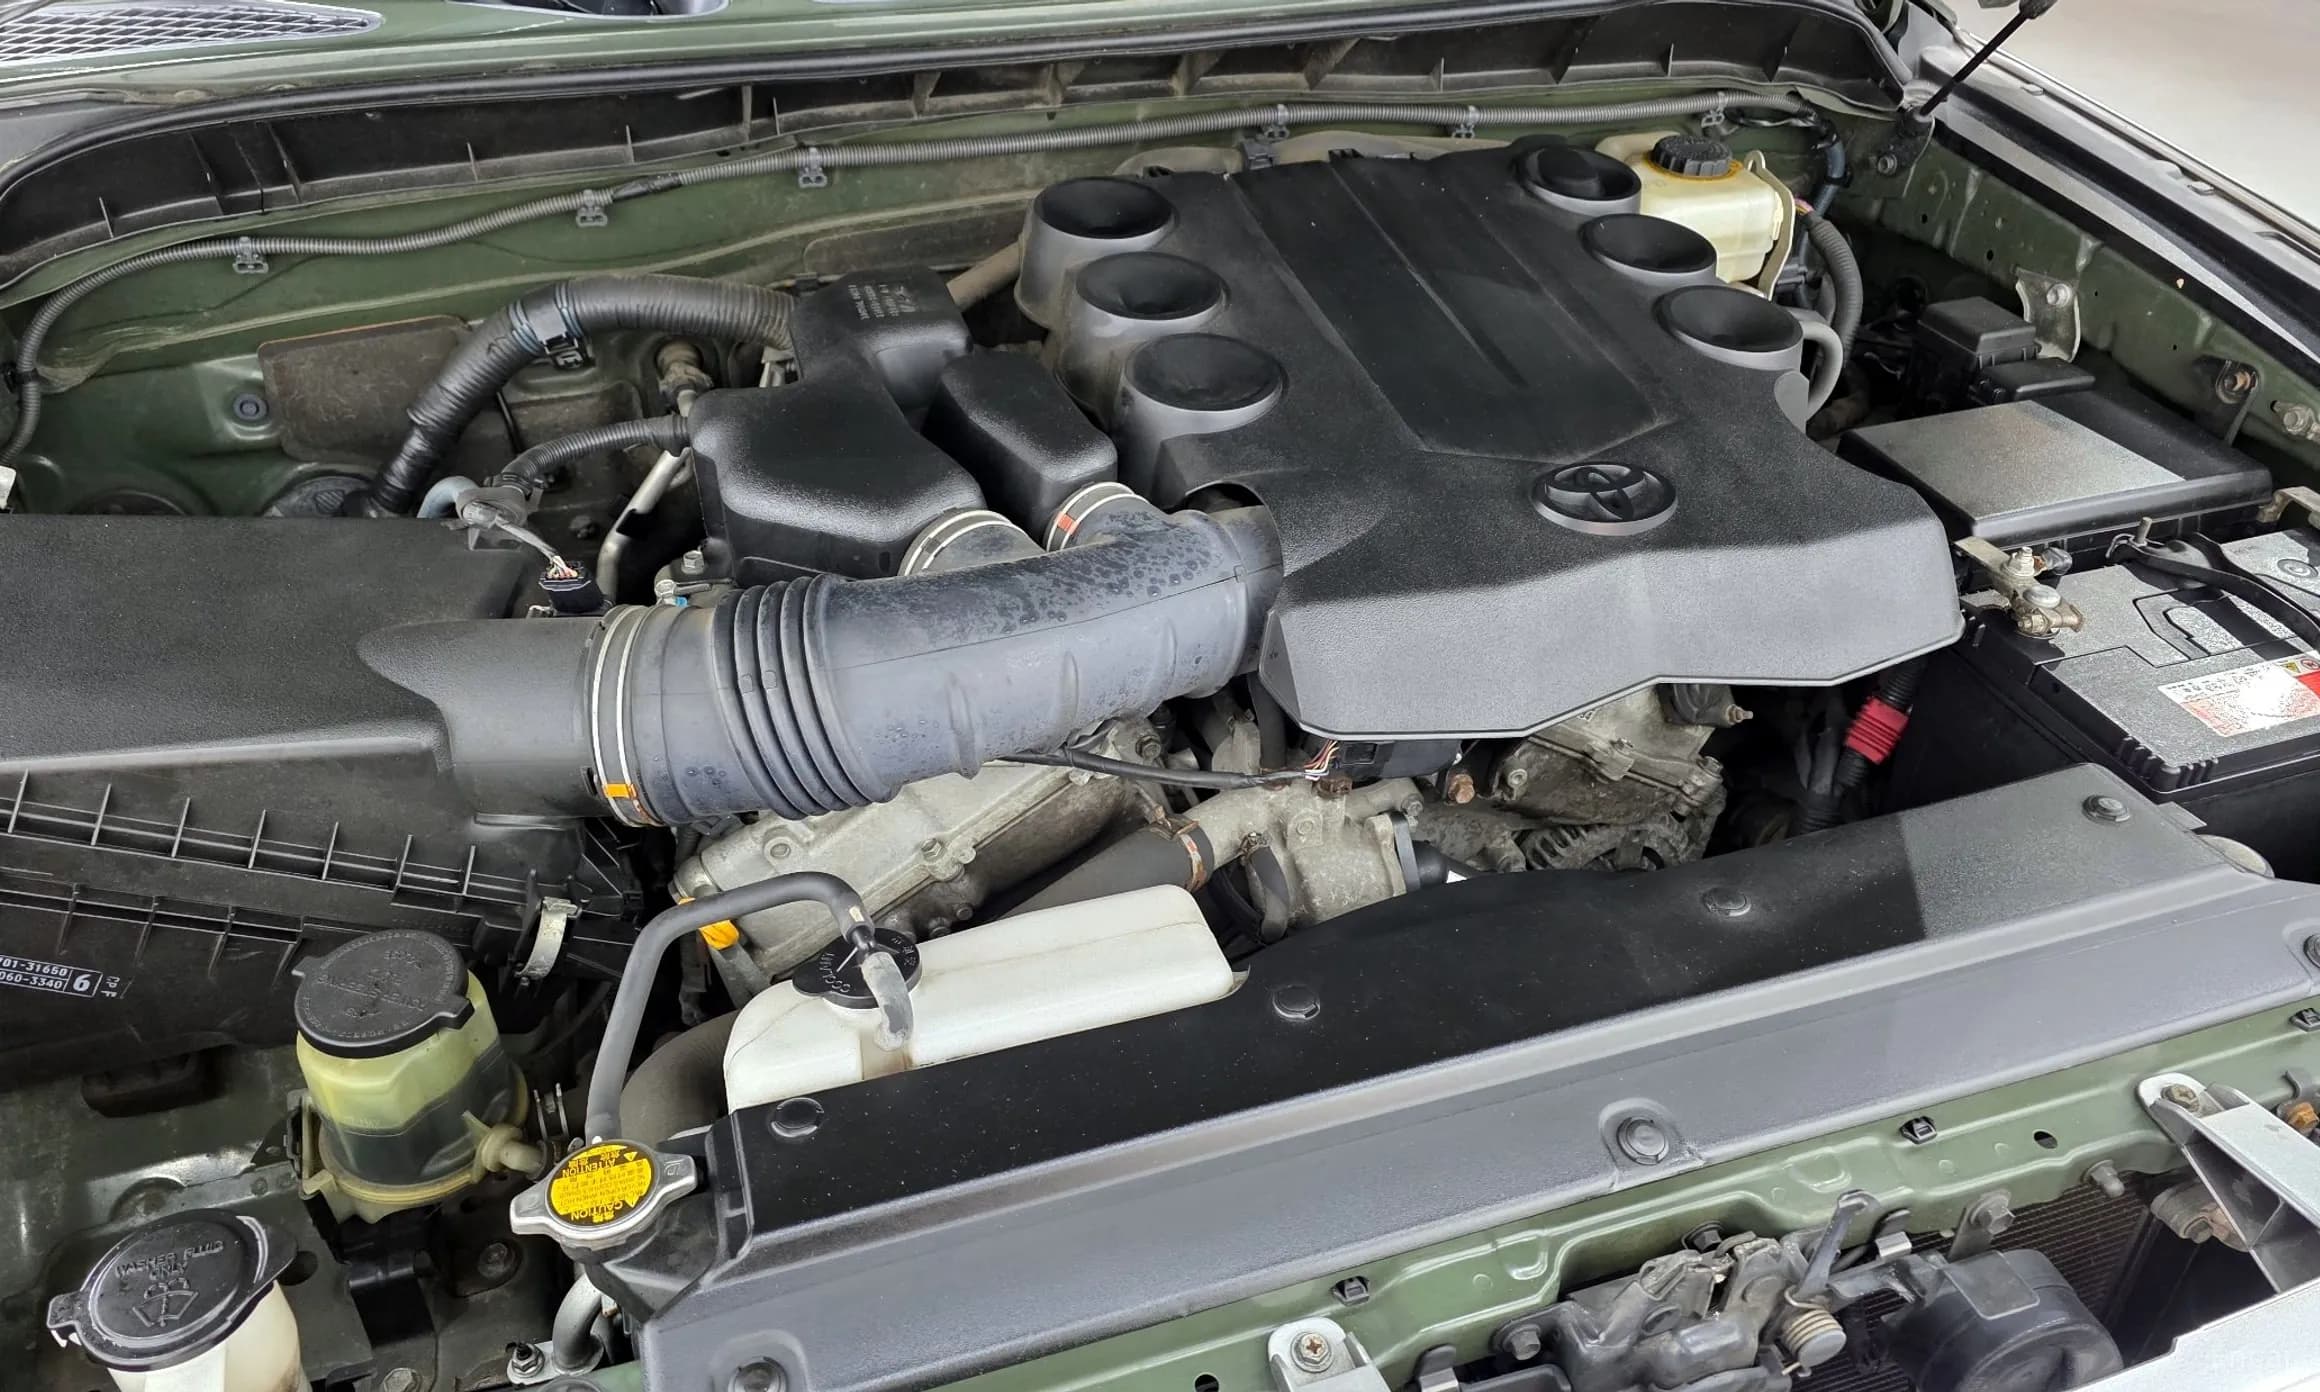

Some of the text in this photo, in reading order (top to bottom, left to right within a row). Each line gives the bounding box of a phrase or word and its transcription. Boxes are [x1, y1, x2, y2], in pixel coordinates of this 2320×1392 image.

[73, 974, 92, 992] 6
[562, 1158, 616, 1178] ATTENTION
[570, 1200, 624, 1221] CAUTION
[115, 1253, 177, 1278] WASHER
